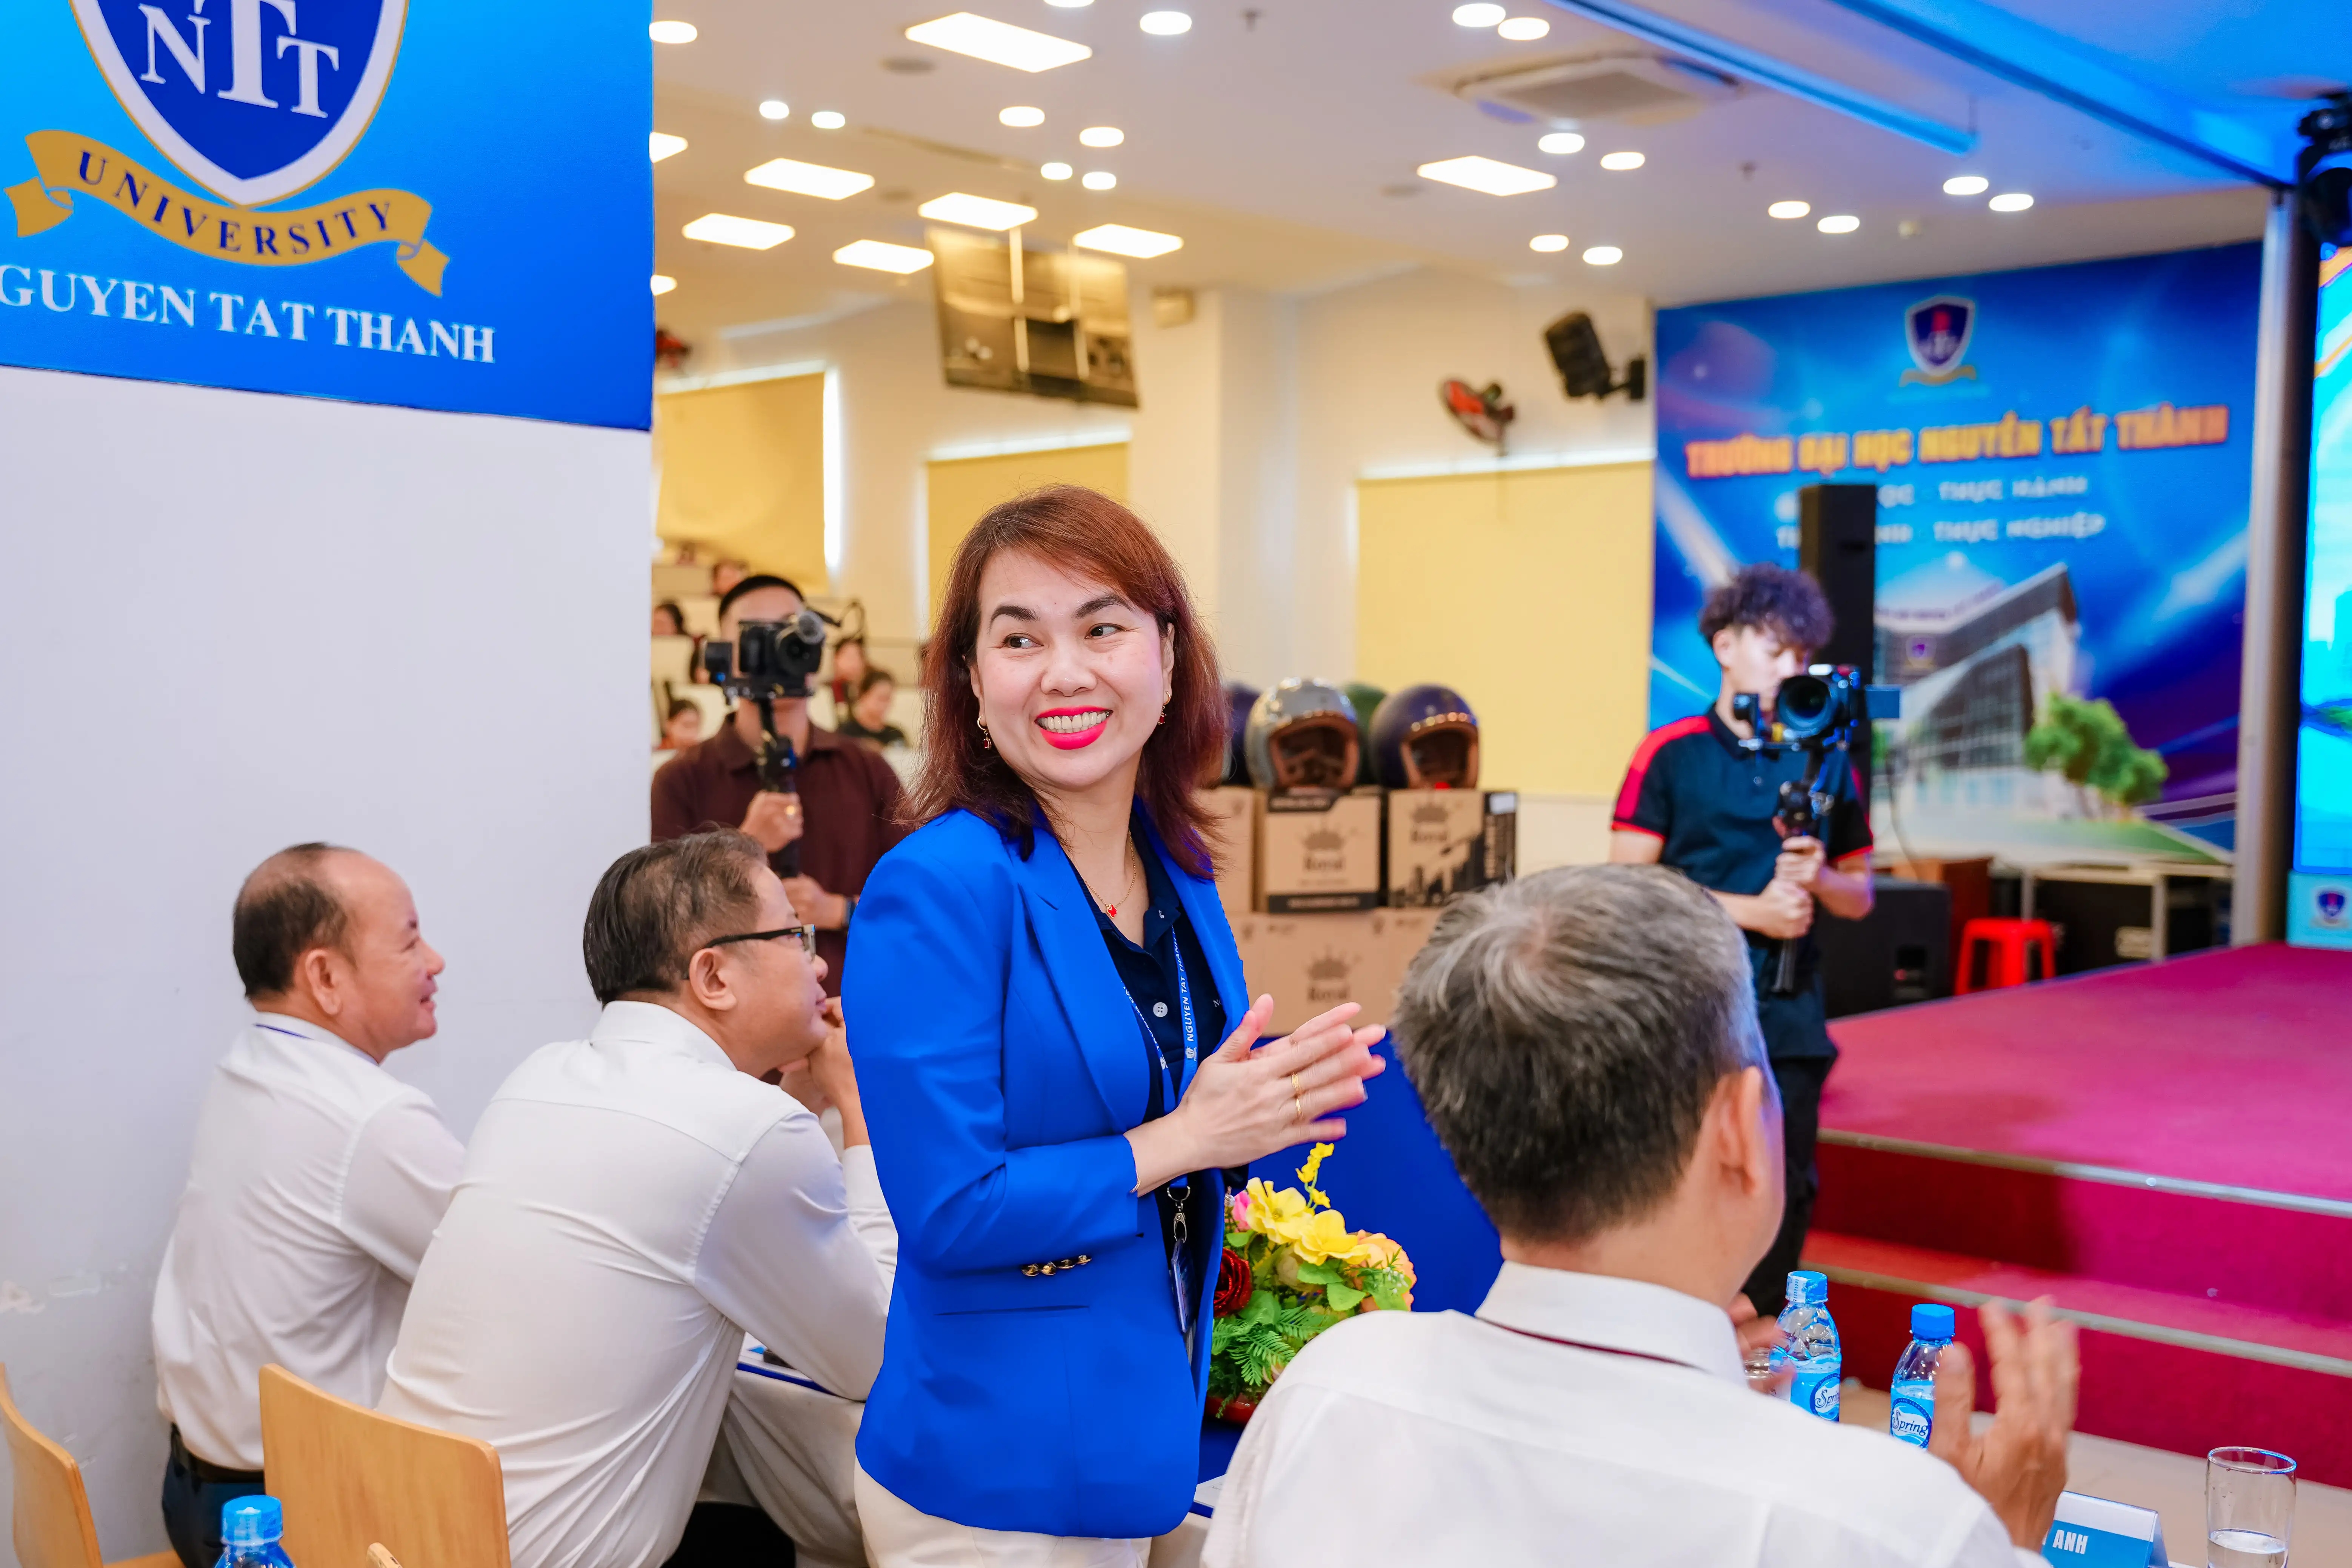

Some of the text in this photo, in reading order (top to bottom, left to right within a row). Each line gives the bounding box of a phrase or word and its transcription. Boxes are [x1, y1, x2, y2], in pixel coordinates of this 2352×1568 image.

[78, 149, 392, 257] UNIVERSITY
[210, 293, 315, 340] TAT
[326, 307, 496, 363] THANH
[1182, 996, 1194, 1042] NGUYEN
[1892, 1410, 1929, 1436] Spring
[2052, 1529, 2088, 1555] ANH
